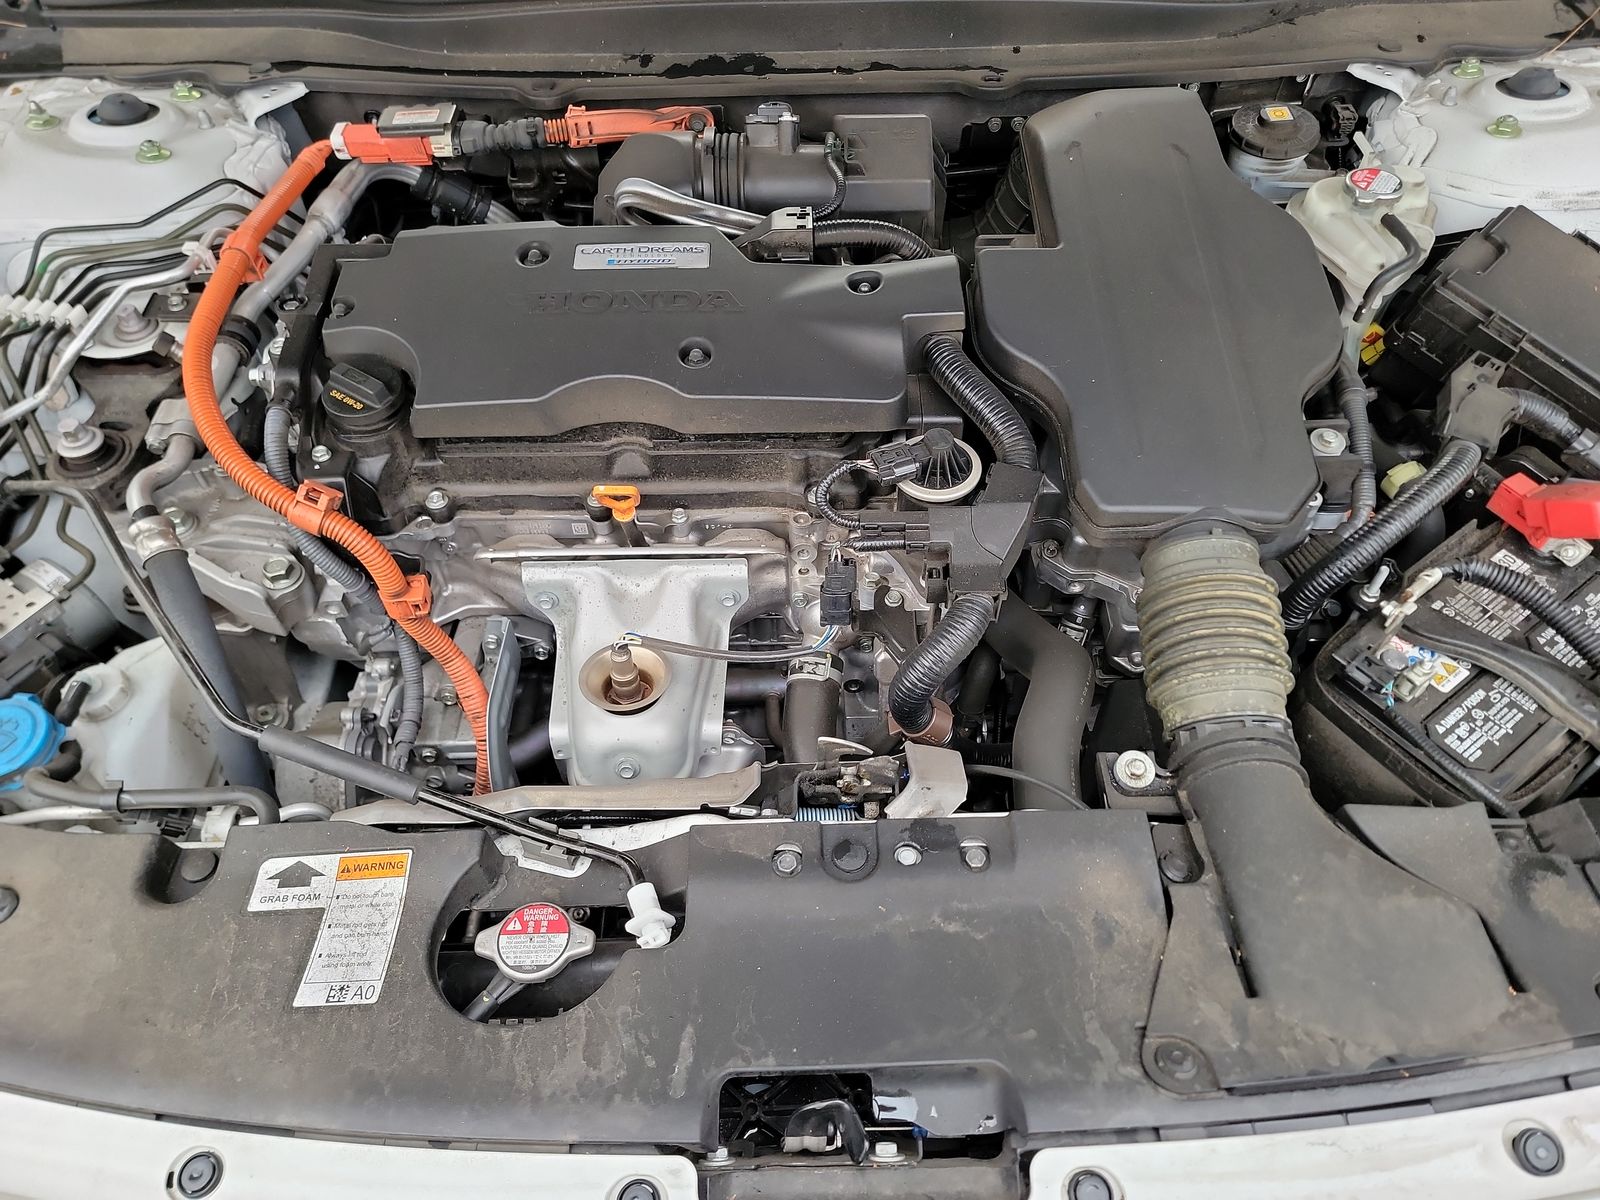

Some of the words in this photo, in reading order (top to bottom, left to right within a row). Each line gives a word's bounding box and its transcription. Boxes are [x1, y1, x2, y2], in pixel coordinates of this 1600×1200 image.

[580, 246, 635, 255] EARTH
[637, 245, 705, 254] DREAMS
[528, 289, 745, 314] HONDA
[329, 389, 346, 401] SAE
[342, 396, 364, 410] 0W-20
[352, 861, 405, 872] WARNING
[259, 894, 289, 904] GRAB
[291, 893, 322, 902] FOAM
[351, 984, 376, 1001] A0
